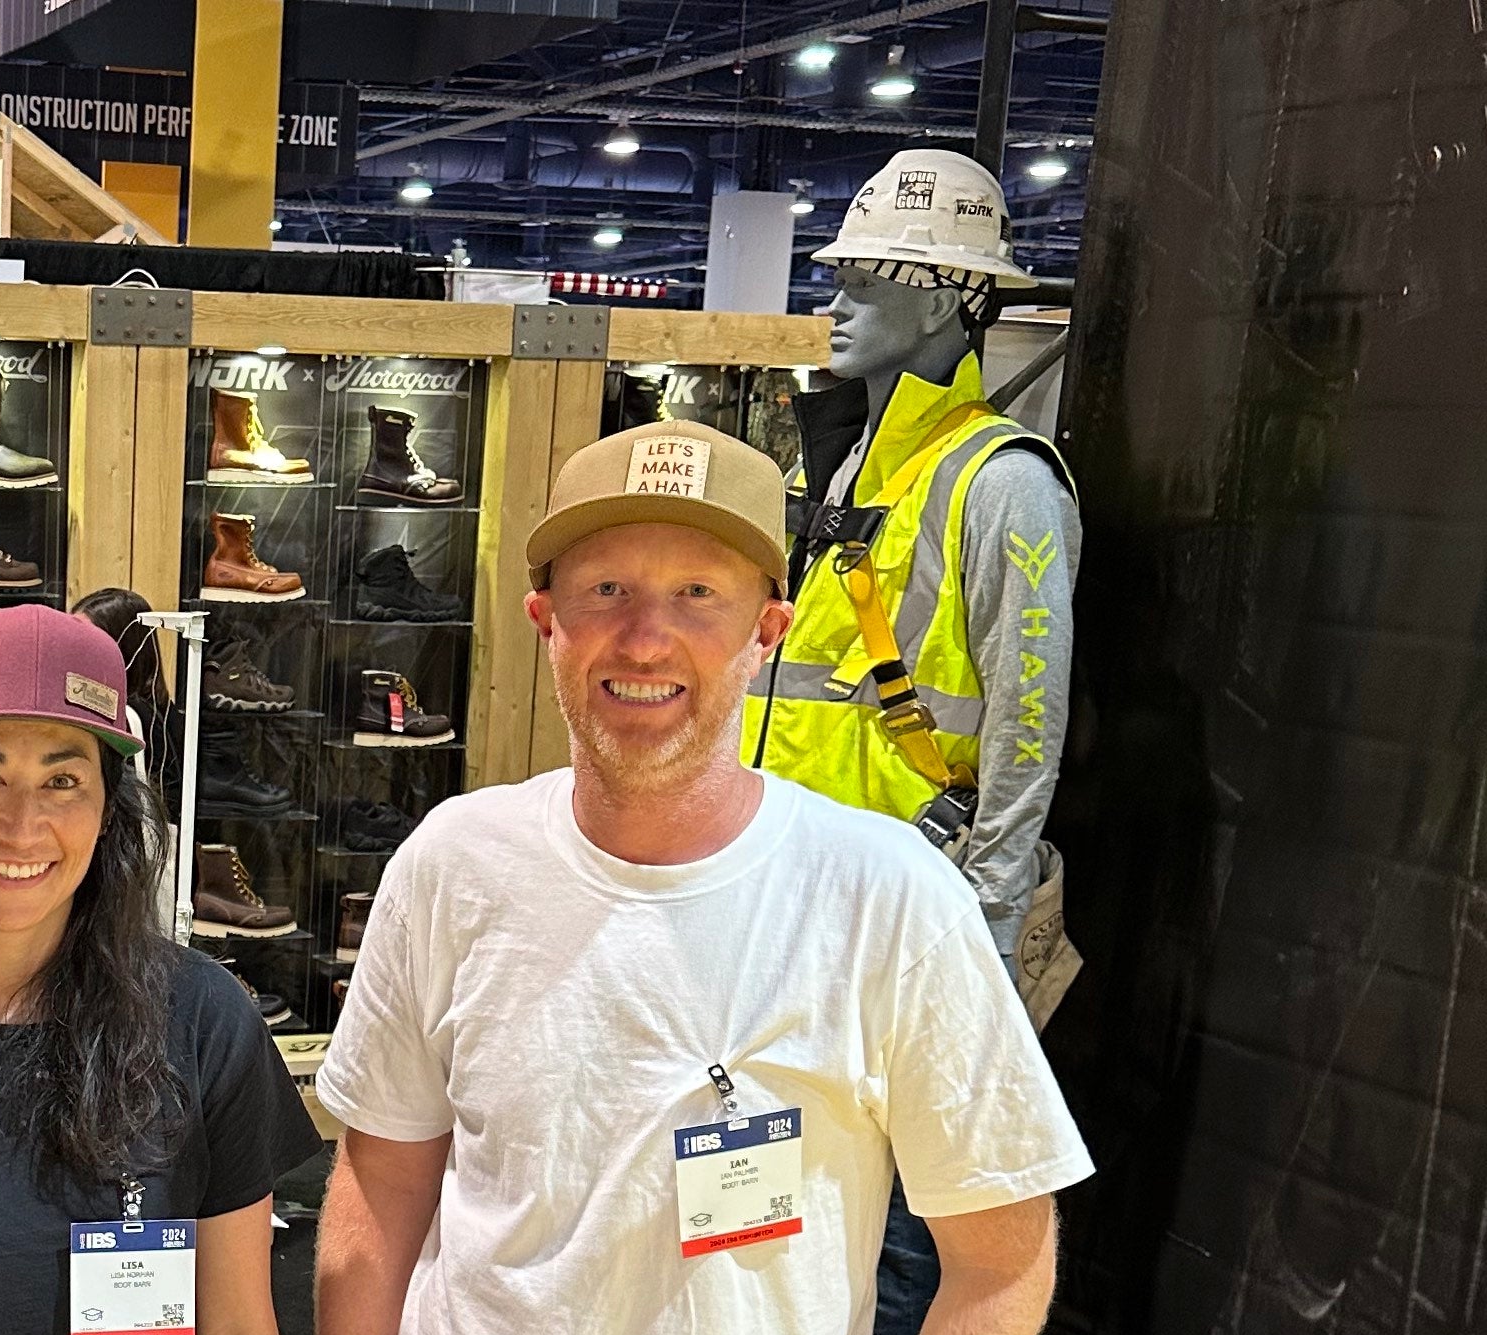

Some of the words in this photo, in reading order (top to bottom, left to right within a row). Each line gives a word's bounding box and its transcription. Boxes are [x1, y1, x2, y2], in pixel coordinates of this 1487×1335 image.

[289, 115, 339, 147] ZONE
[901, 171, 936, 183] YOUR
[897, 195, 930, 209] GOAL
[956, 200, 994, 218] WORK
[188, 358, 295, 391] WORK
[326, 359, 472, 399] Thorogood
[647, 442, 694, 457] LET'S
[641, 461, 695, 478] MAKE
[637, 481, 649, 493] A
[654, 480, 694, 496] HAT
[1013, 606, 1050, 766] HAWX
[690, 1132, 723, 1153] IBS
[767, 1117, 793, 1134] 2024
[730, 1158, 749, 1169] IAN
[86, 1232, 117, 1249] IBS
[162, 1228, 186, 1241] 2024
[121, 1261, 144, 1270] LISA
